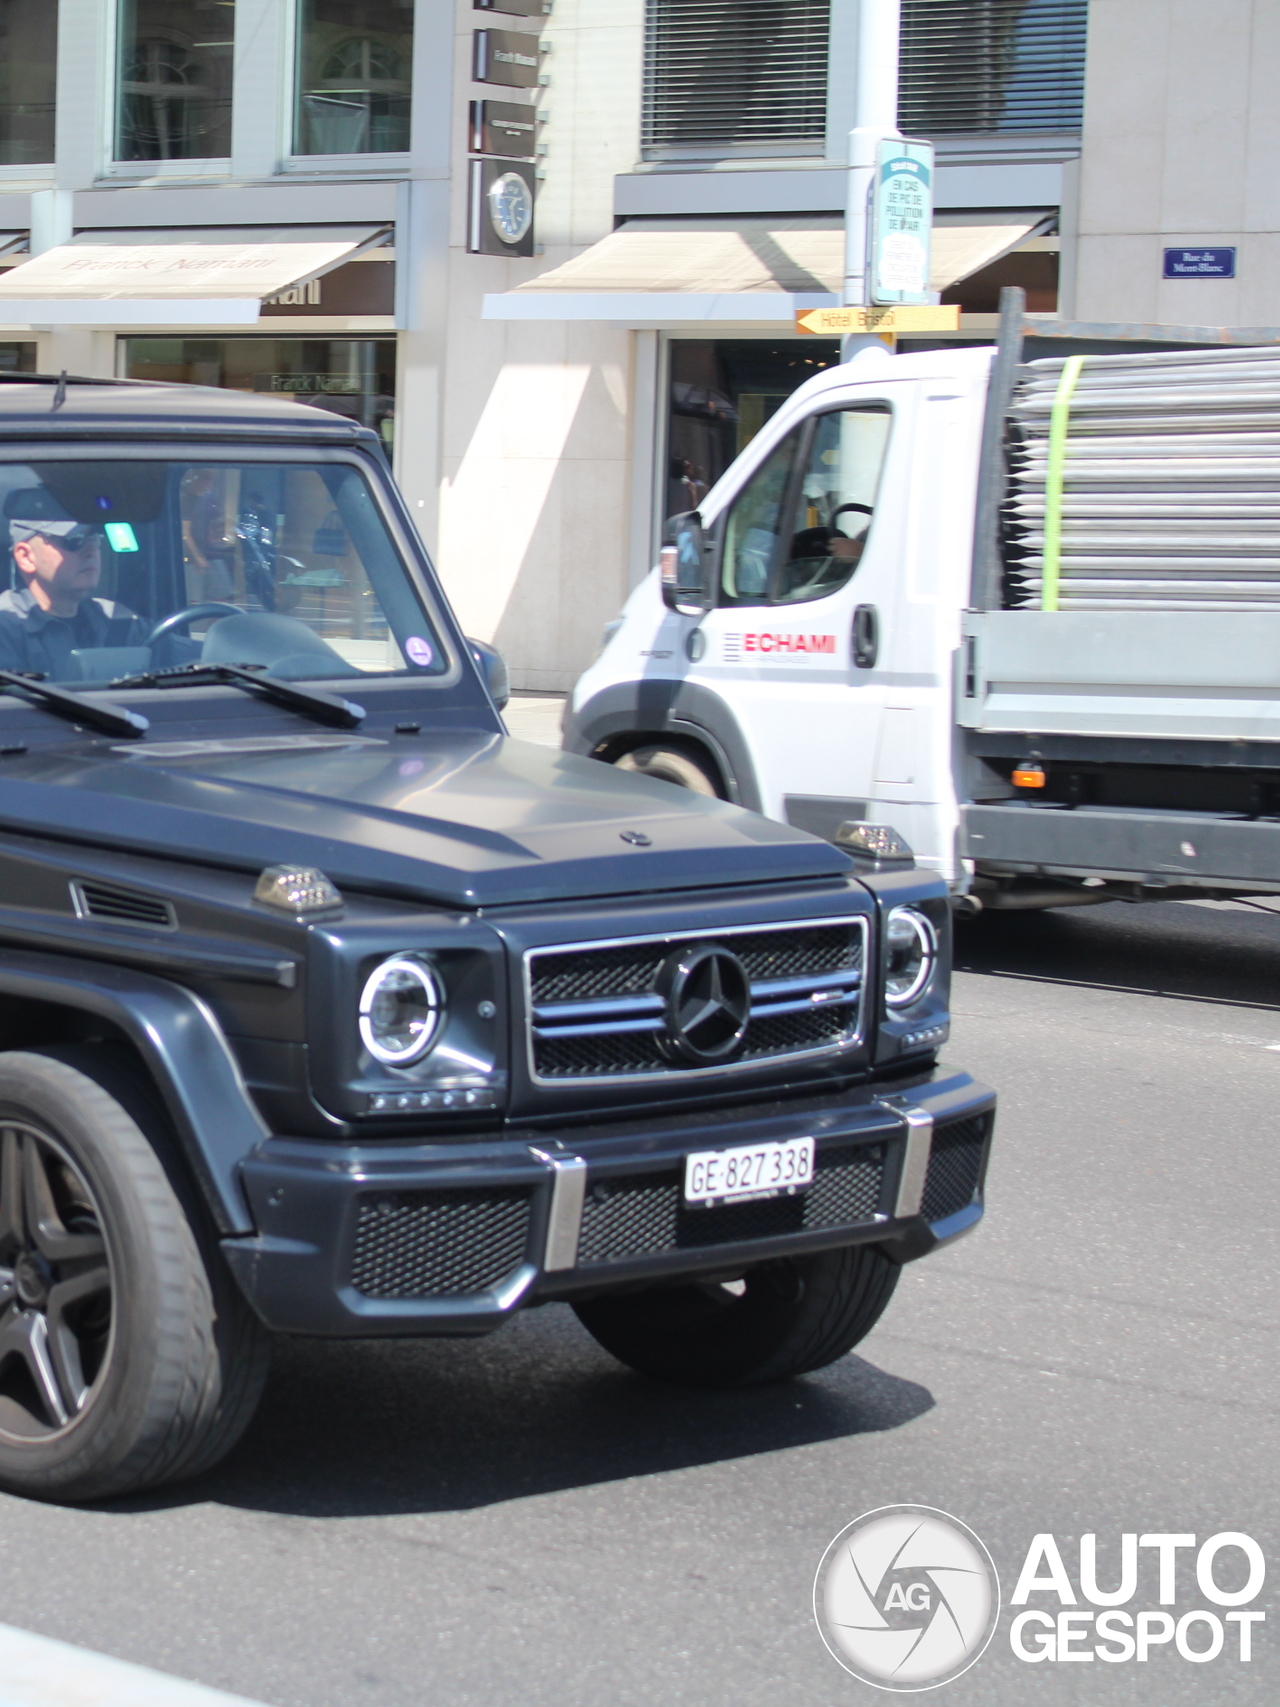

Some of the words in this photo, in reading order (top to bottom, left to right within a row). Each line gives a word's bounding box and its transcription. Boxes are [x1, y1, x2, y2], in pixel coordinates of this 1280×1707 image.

[904, 181, 919, 192] CAS
[888, 192, 898, 203] DE
[912, 194, 923, 205] DE
[885, 205, 924, 218] POLLUTION
[888, 218, 898, 230] DE
[1182, 252, 1201, 262] Rue
[1201, 252, 1216, 262] du
[1173, 262, 1225, 273] Mont-Blanc
[821, 312, 852, 328] Hôtel
[271, 375, 312, 391] Franck
[744, 633, 837, 654] ECHAMI
[770, 1147, 809, 1182] 338
